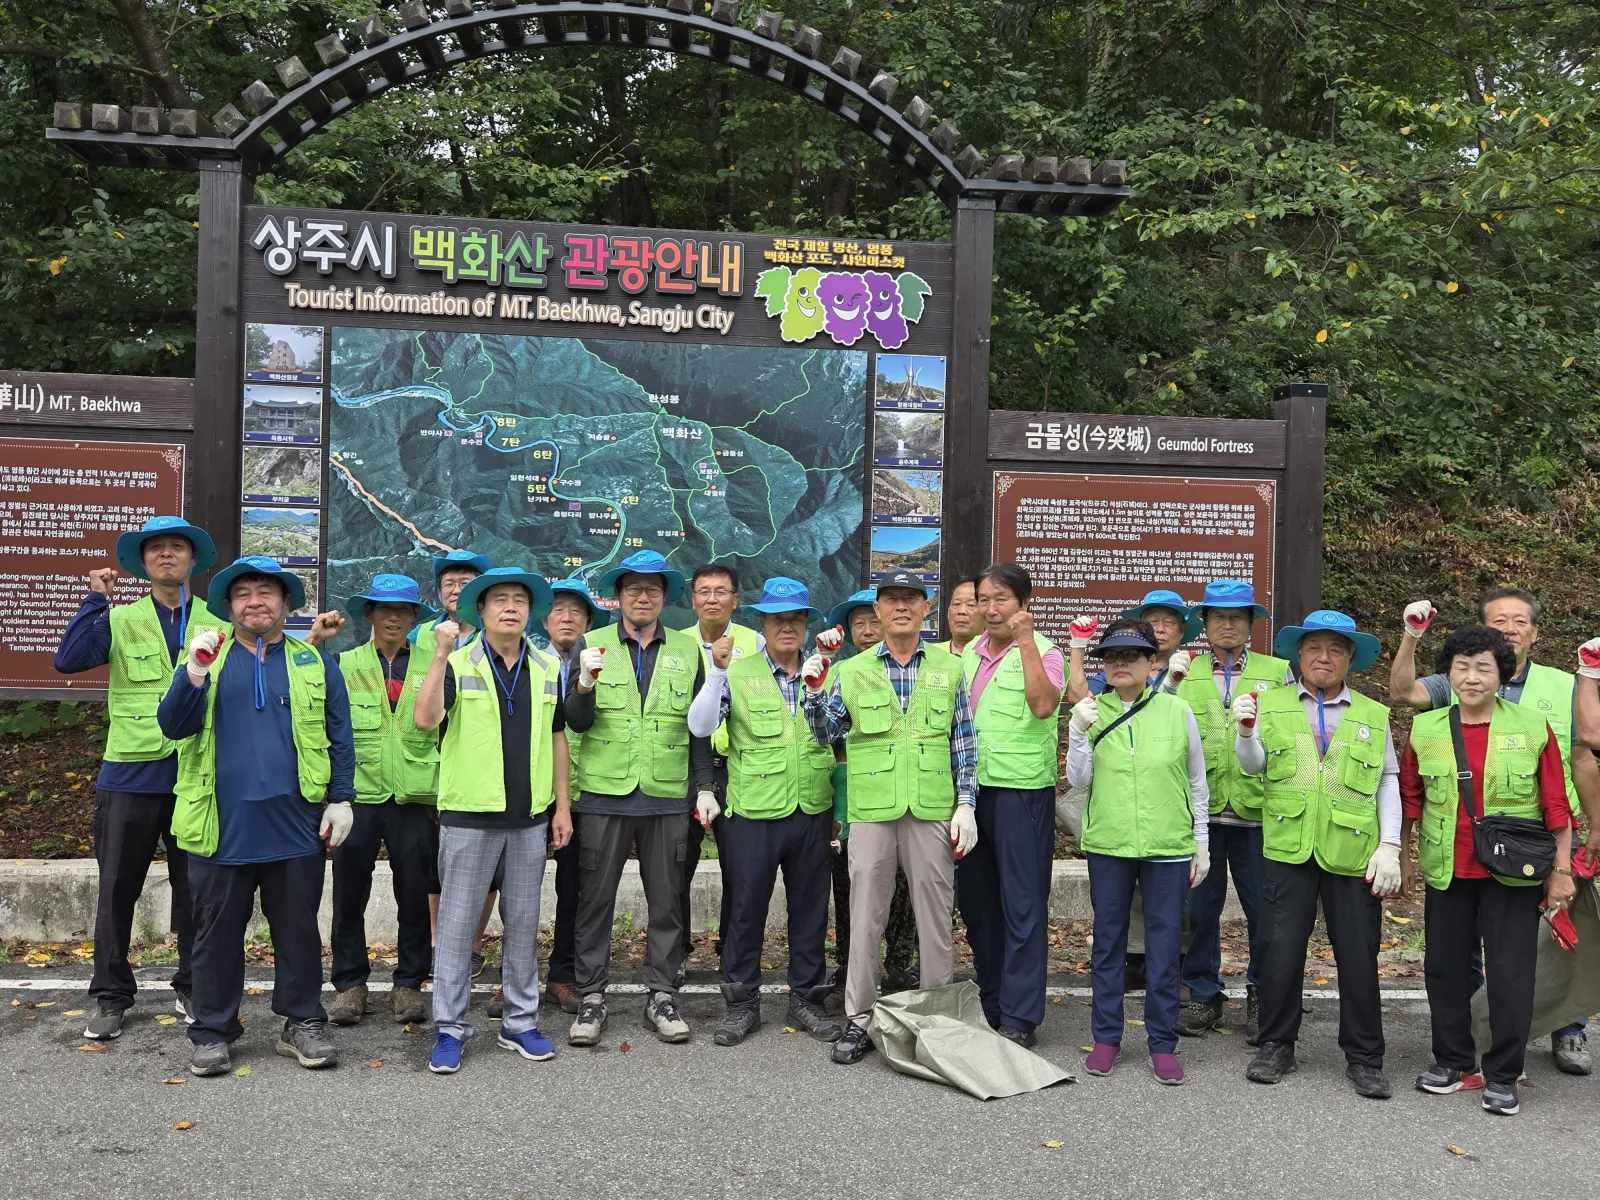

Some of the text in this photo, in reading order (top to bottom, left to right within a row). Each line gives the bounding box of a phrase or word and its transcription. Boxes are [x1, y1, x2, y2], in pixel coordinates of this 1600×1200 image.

[773, 239, 799, 251] 전국
[803, 240, 829, 252] 제일
[867, 243, 893, 256] 명품
[252, 217, 741, 292] 상주시 백화산 관광안내
[764, 251, 803, 263] 백화산
[840, 255, 905, 268] 샤인머스켓
[285, 283, 734, 335] Tourist Information of MT. Baekhwa, Sangju City
[50, 395, 76, 411] MT.
[80, 396, 141, 412] Baekhwa
[497, 418, 516, 427] 8탄
[662, 428, 702, 439] 백화산
[502, 438, 520, 446] 7탄
[1025, 423, 1254, 454] 금돌성(今突城) Geumdol Fortress
[533, 451, 553, 459] 6탄
[527, 484, 546, 493] 5탄
[621, 497, 639, 505] 4탄
[625, 538, 643, 547] 3탄
[564, 558, 582, 566] 2탄
[55, 574, 80, 582] Sangju,
[45, 583, 70, 591] highest
[46, 592, 69, 600] valleys
[10, 600, 17, 608] by
[1081, 597, 1104, 605] fortress,
[24, 609, 59, 617] Mongolian
[9, 644, 34, 652] Temple
